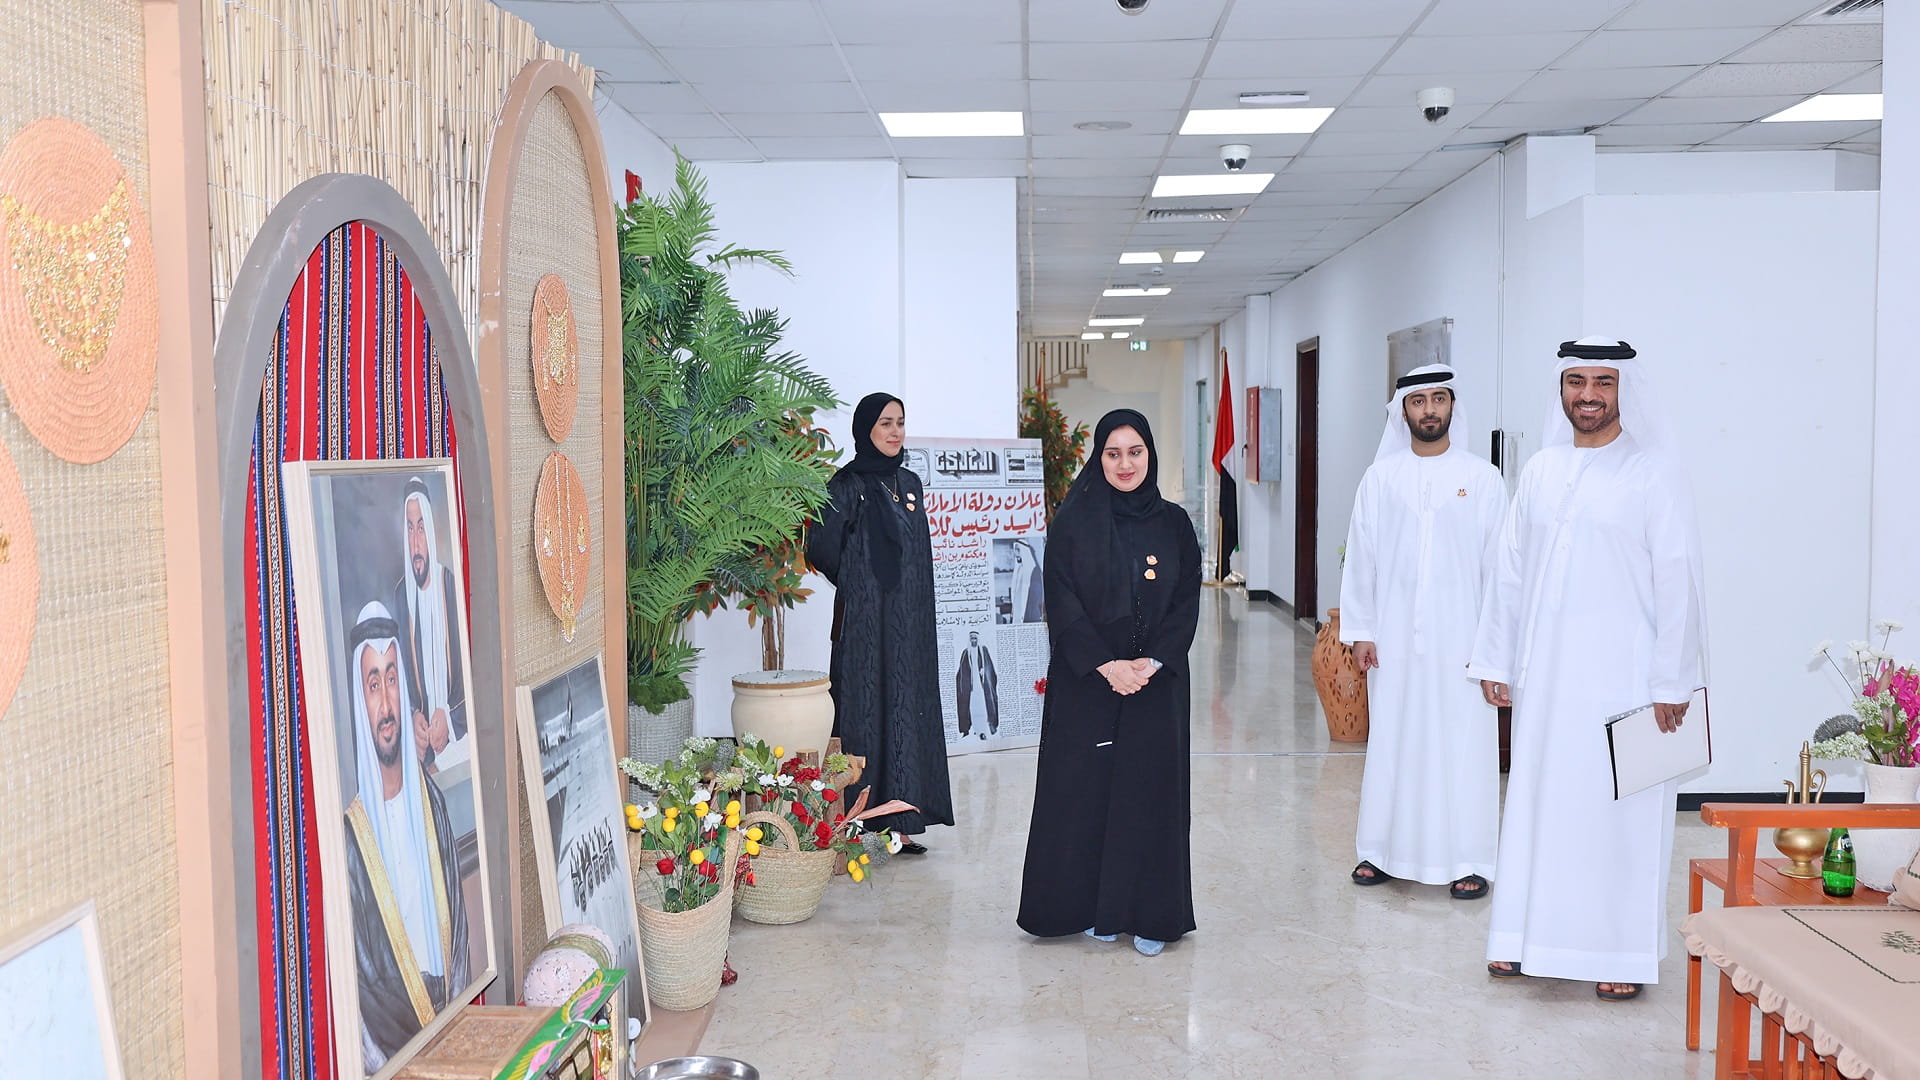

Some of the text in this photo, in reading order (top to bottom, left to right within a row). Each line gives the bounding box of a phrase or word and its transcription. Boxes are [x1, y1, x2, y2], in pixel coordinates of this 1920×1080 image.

[968, 492, 1002, 511] دولة
[1004, 490, 1042, 511] علان
[929, 511, 1047, 537] زايد رئيس للا
[933, 536, 987, 550] راشد نائب
[930, 551, 947, 563] راش
